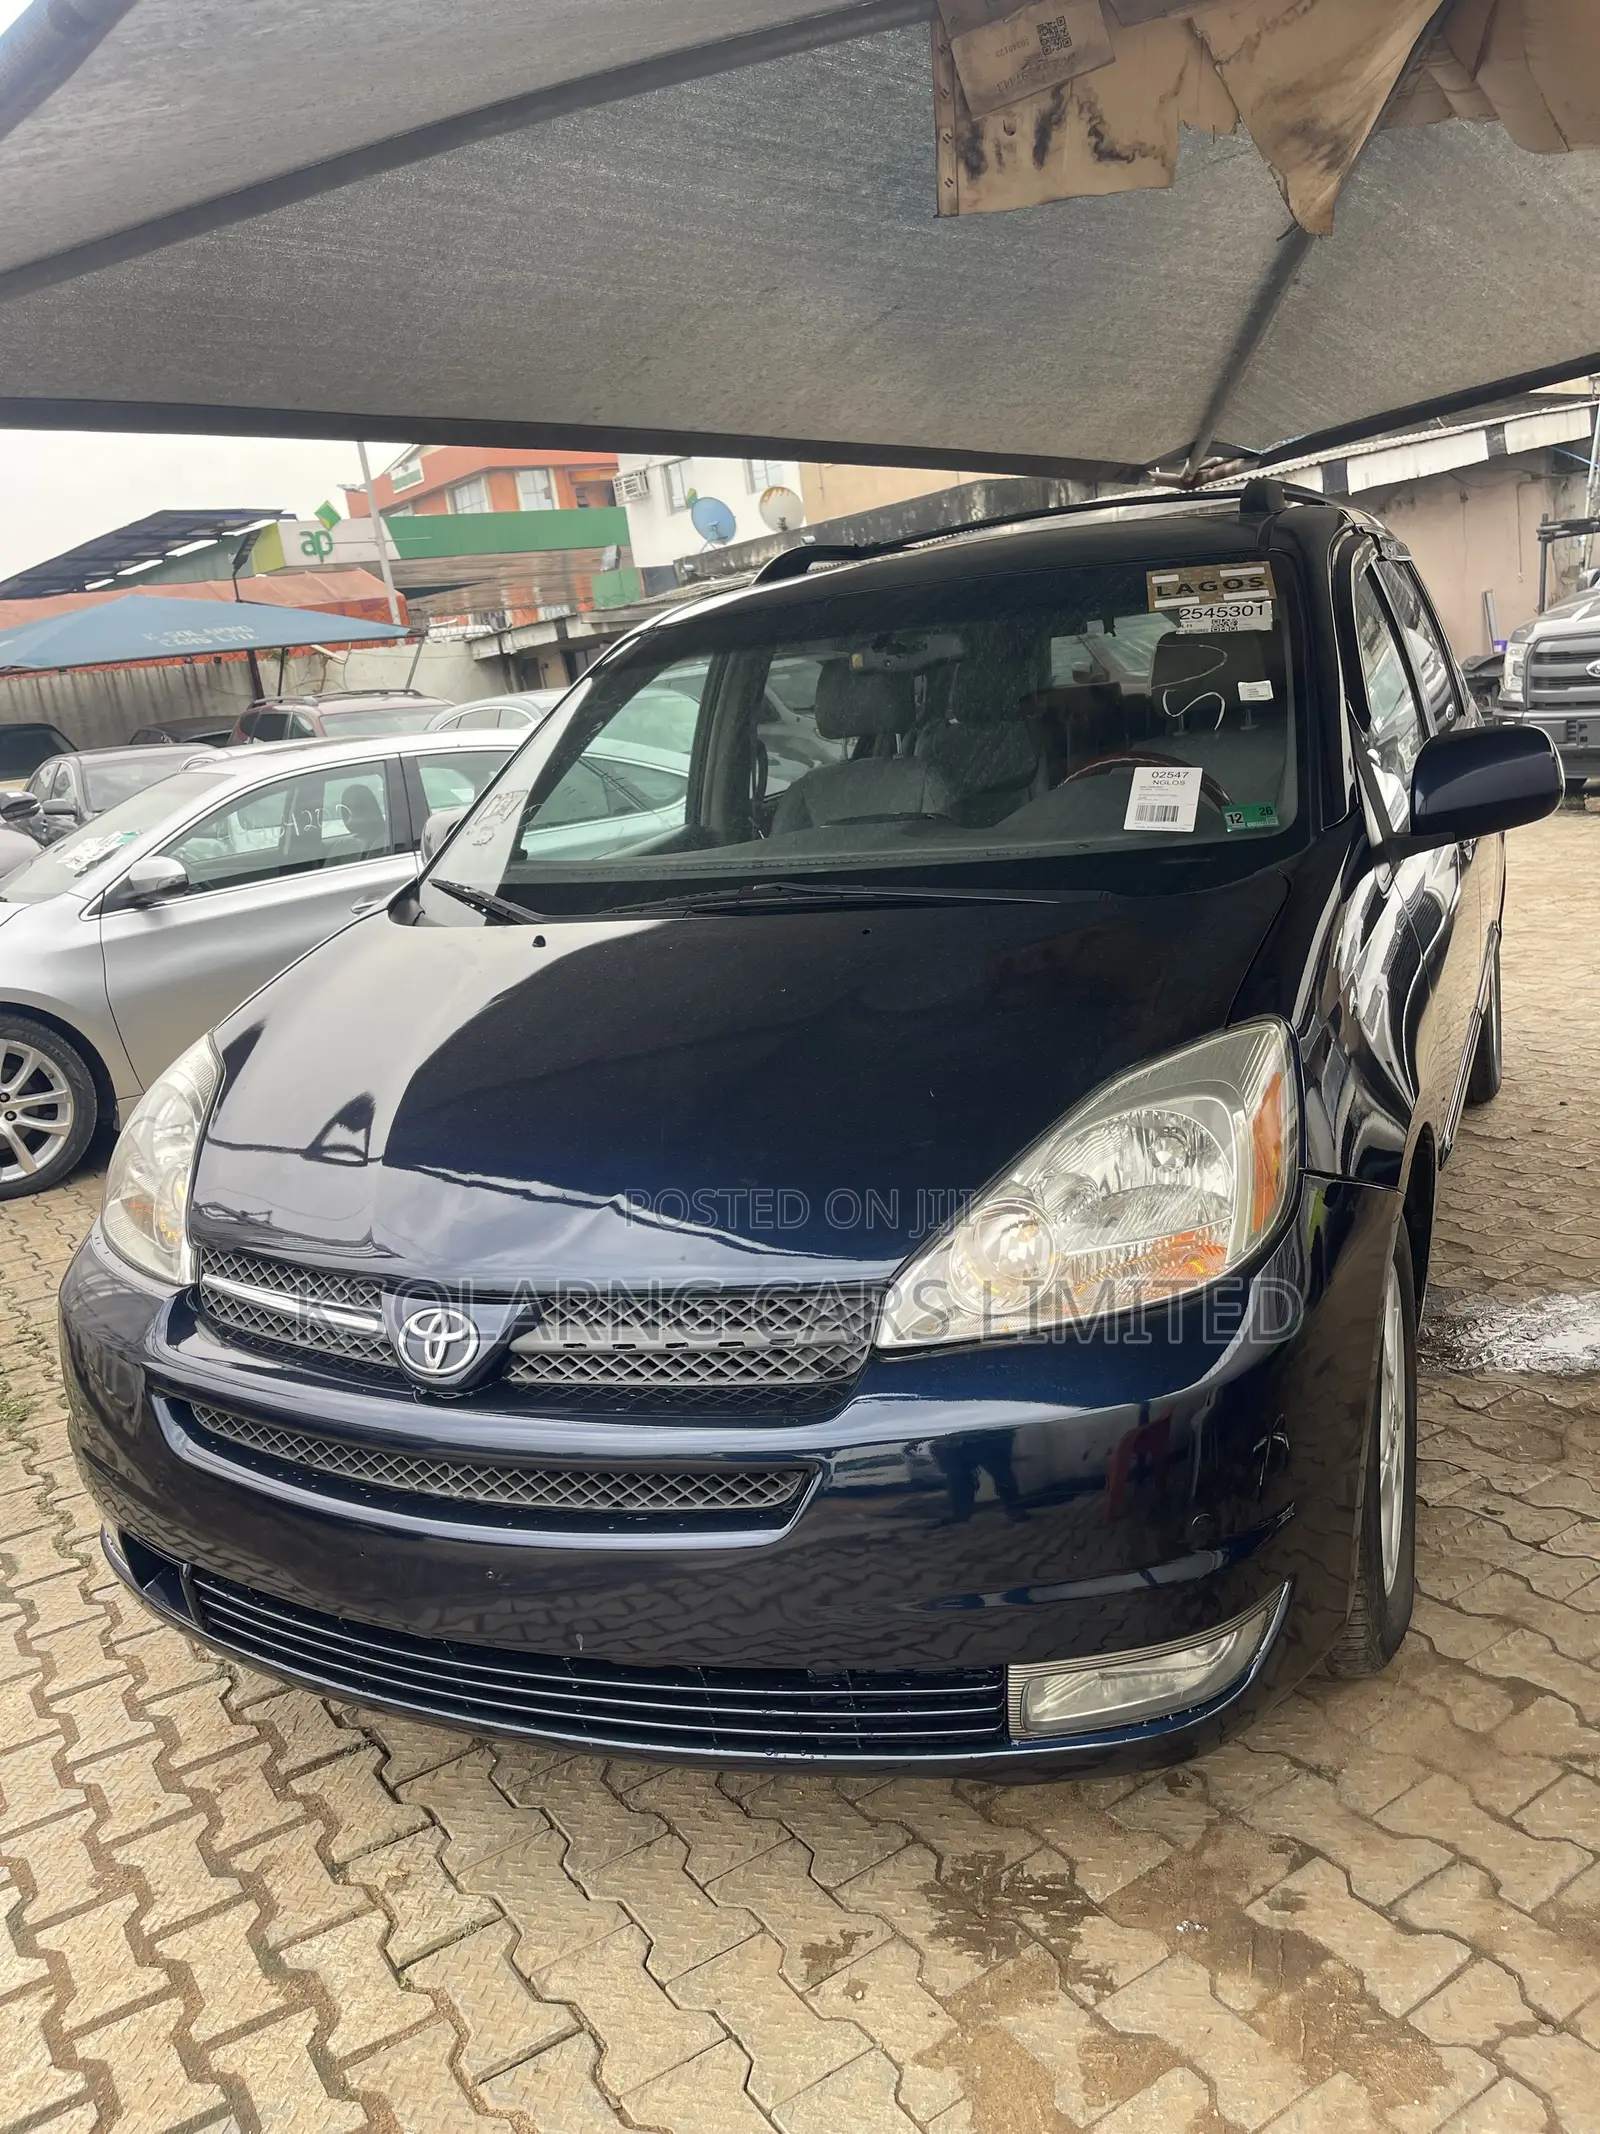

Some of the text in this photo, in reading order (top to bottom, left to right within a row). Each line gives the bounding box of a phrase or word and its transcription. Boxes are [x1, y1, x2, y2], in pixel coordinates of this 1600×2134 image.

[299, 531, 333, 564] ap
[1156, 576, 1264, 597] LAGOS
[1178, 604, 1264, 621] 2545301
[1151, 770, 1190, 779] 02547
[1227, 812, 1244, 825] 12
[1259, 806, 1273, 816] 26
